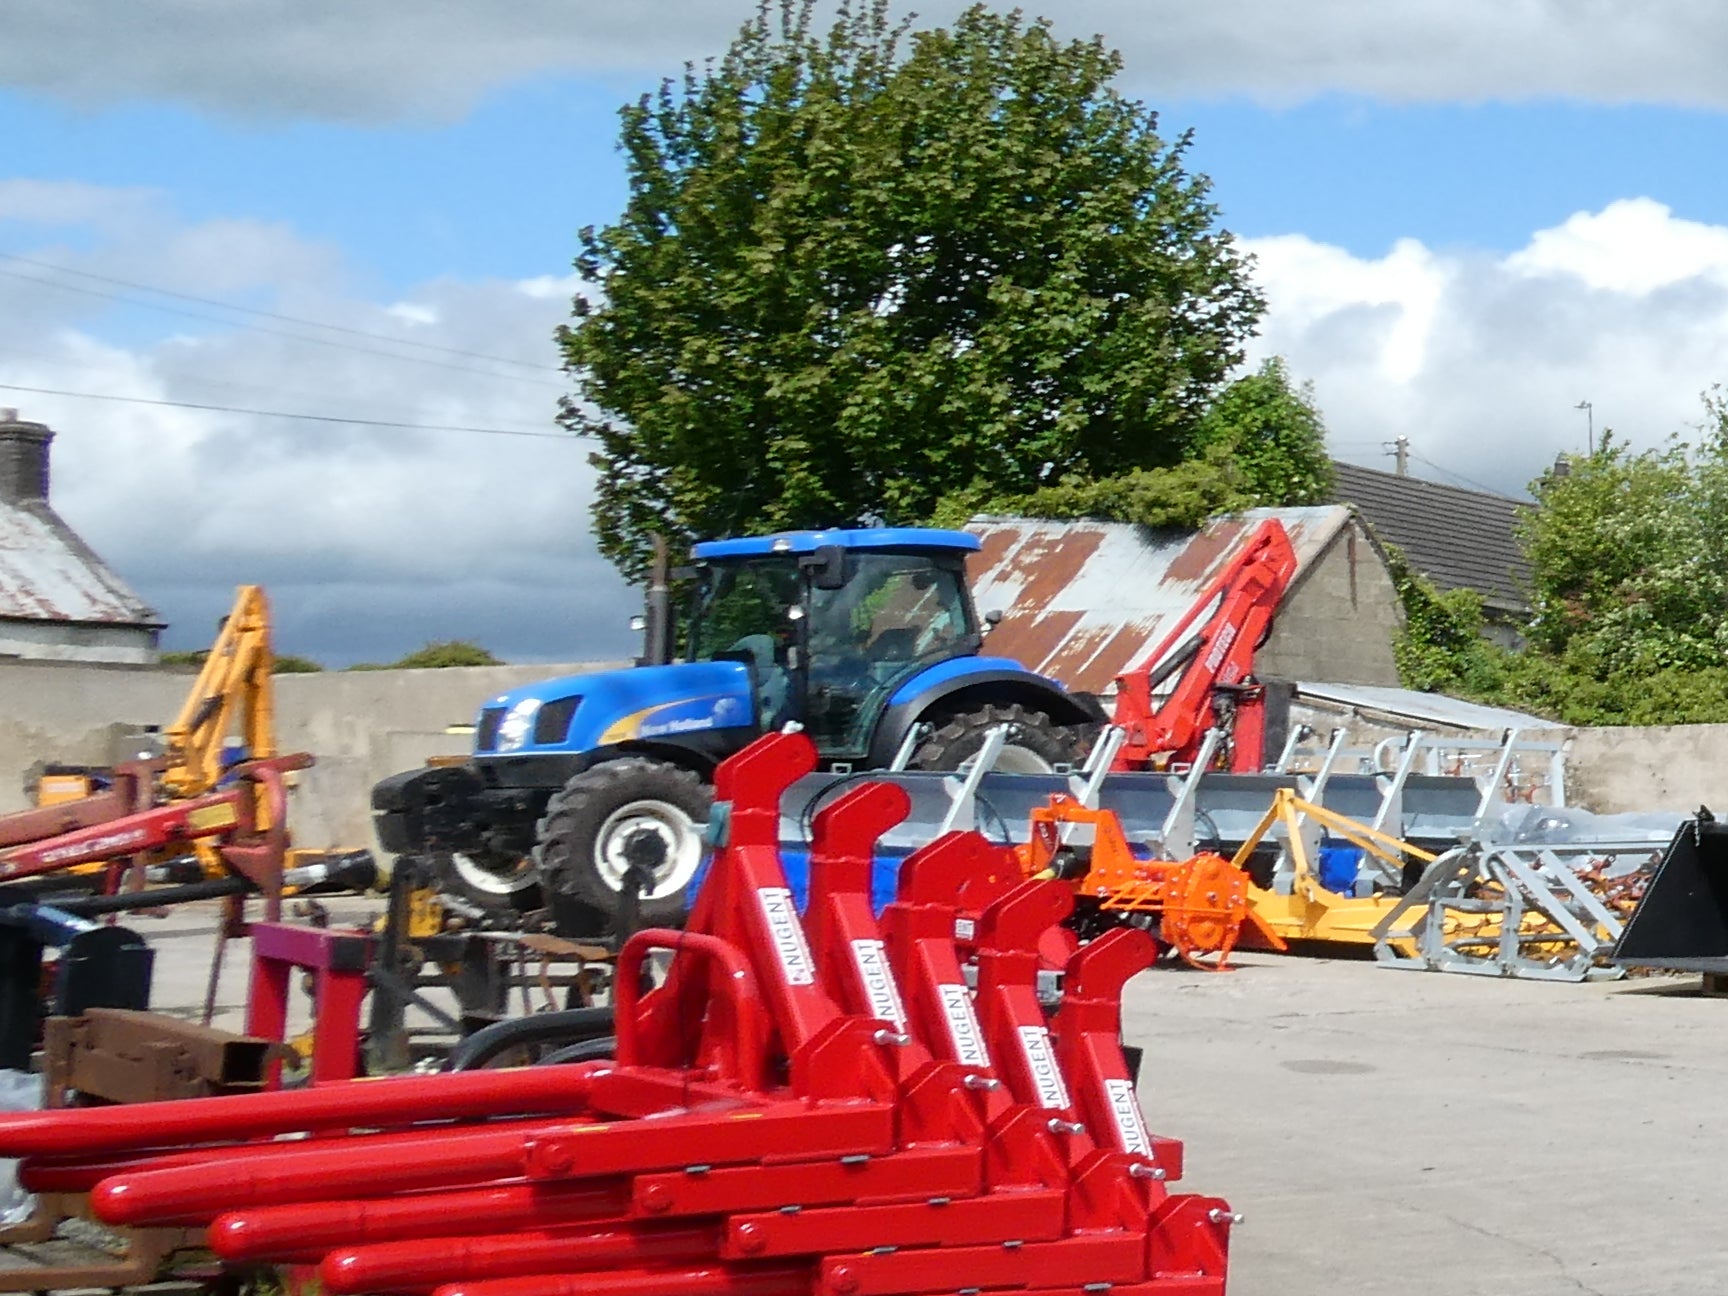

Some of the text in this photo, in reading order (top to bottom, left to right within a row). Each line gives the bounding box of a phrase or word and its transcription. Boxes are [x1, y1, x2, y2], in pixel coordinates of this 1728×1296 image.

[765, 891, 803, 967] NUGENT
[858, 943, 895, 1017] NUGENT
[944, 988, 980, 1060] NUGENT
[1024, 1030, 1060, 1102] NUGENT
[1110, 1083, 1142, 1154] NUGENT
